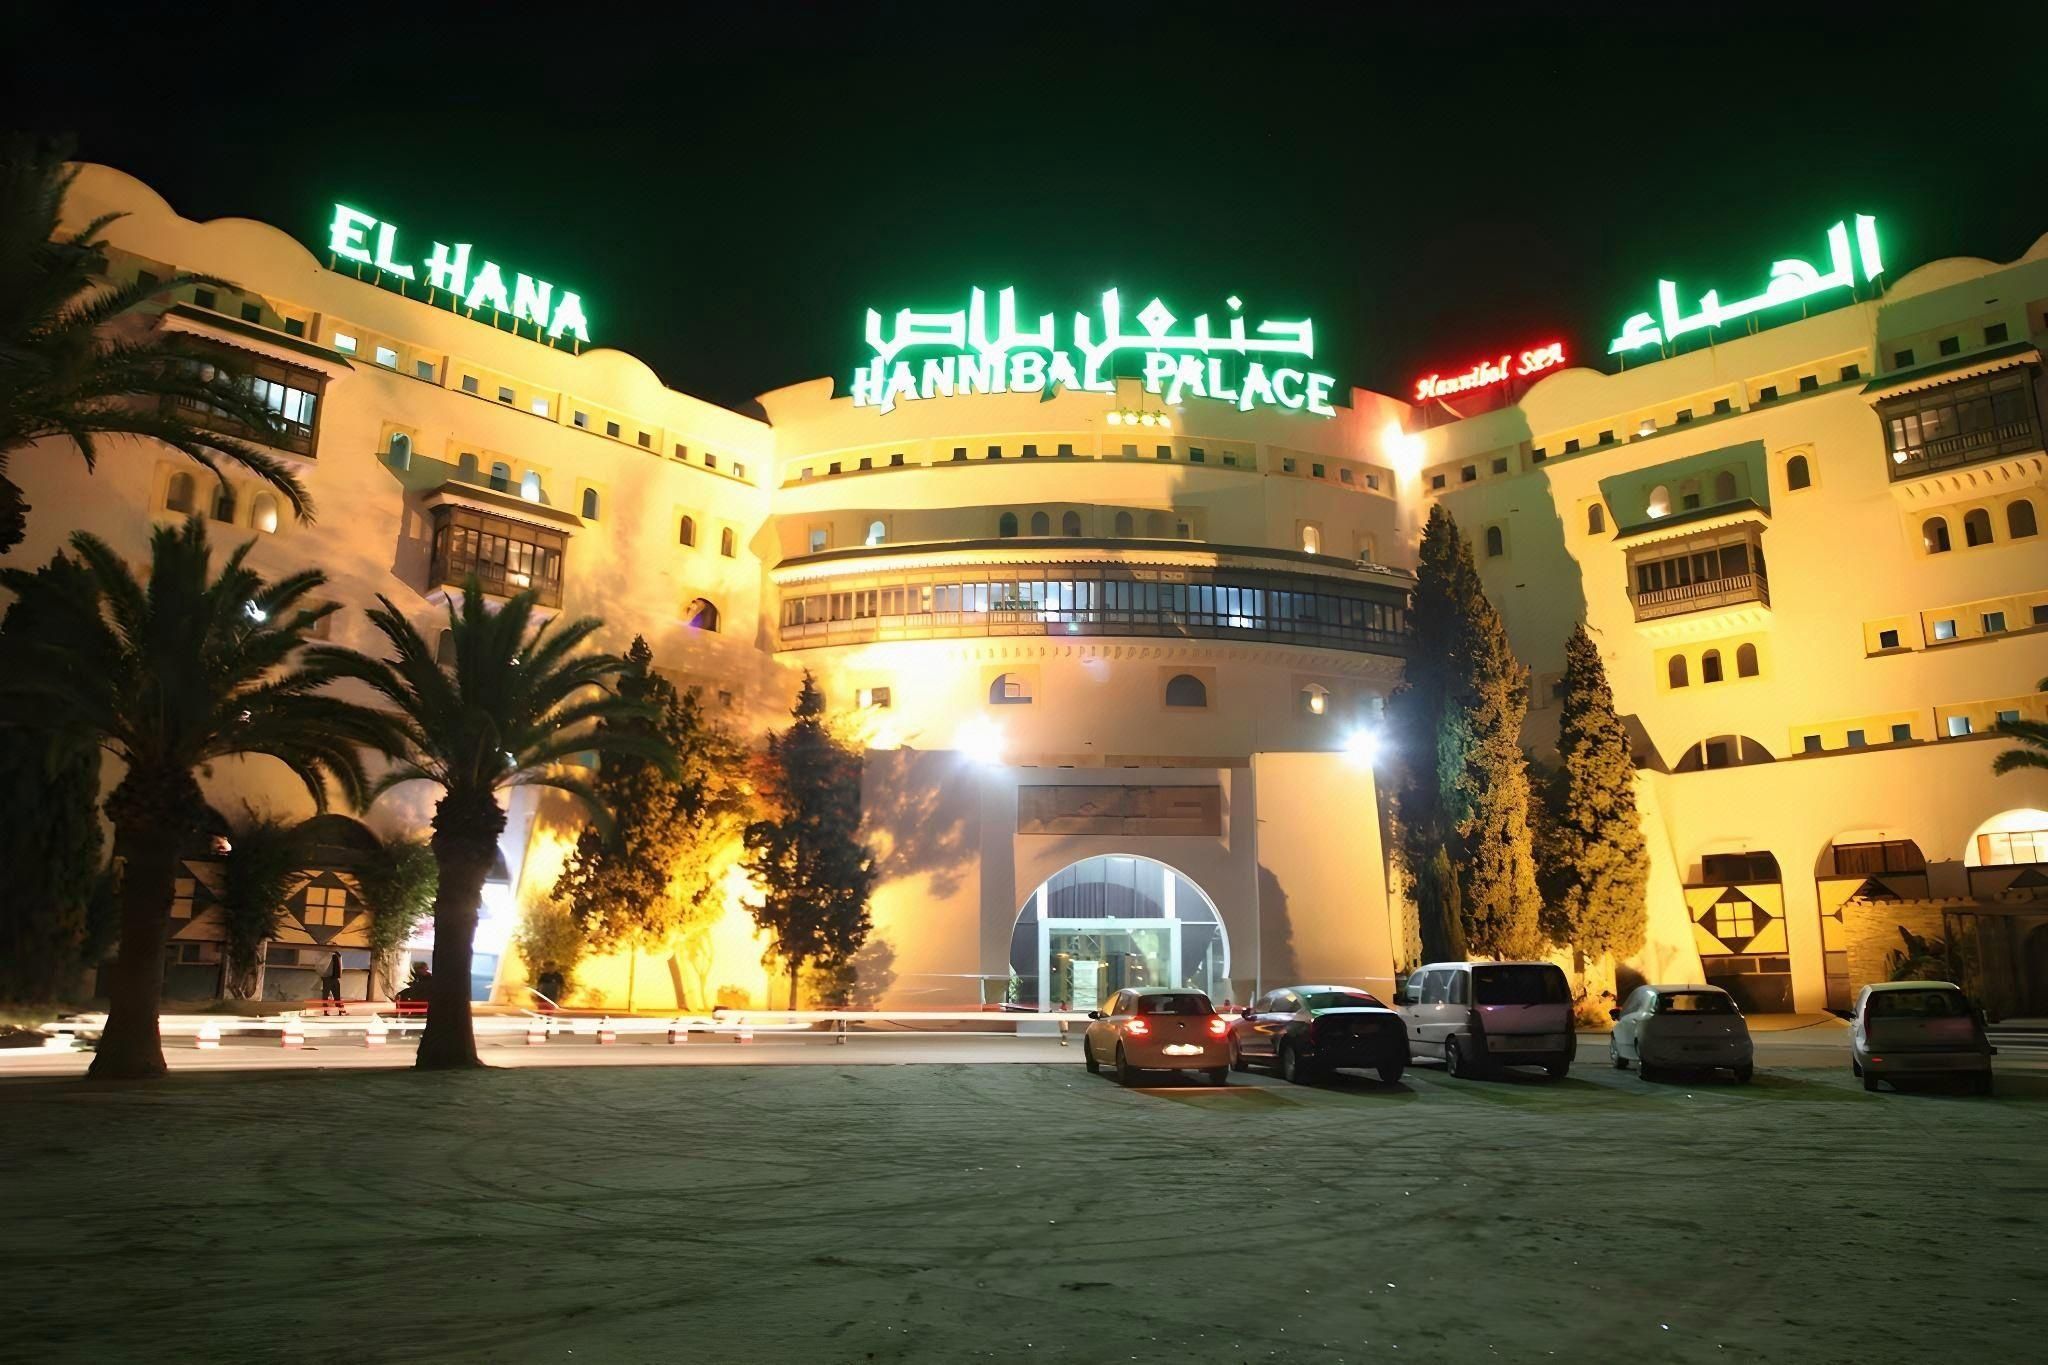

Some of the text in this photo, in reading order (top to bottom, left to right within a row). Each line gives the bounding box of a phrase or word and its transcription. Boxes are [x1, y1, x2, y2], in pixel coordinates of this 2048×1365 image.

[328, 203, 591, 343] EL HANA
[850, 350, 1337, 417] HANNIBAL PALACE
